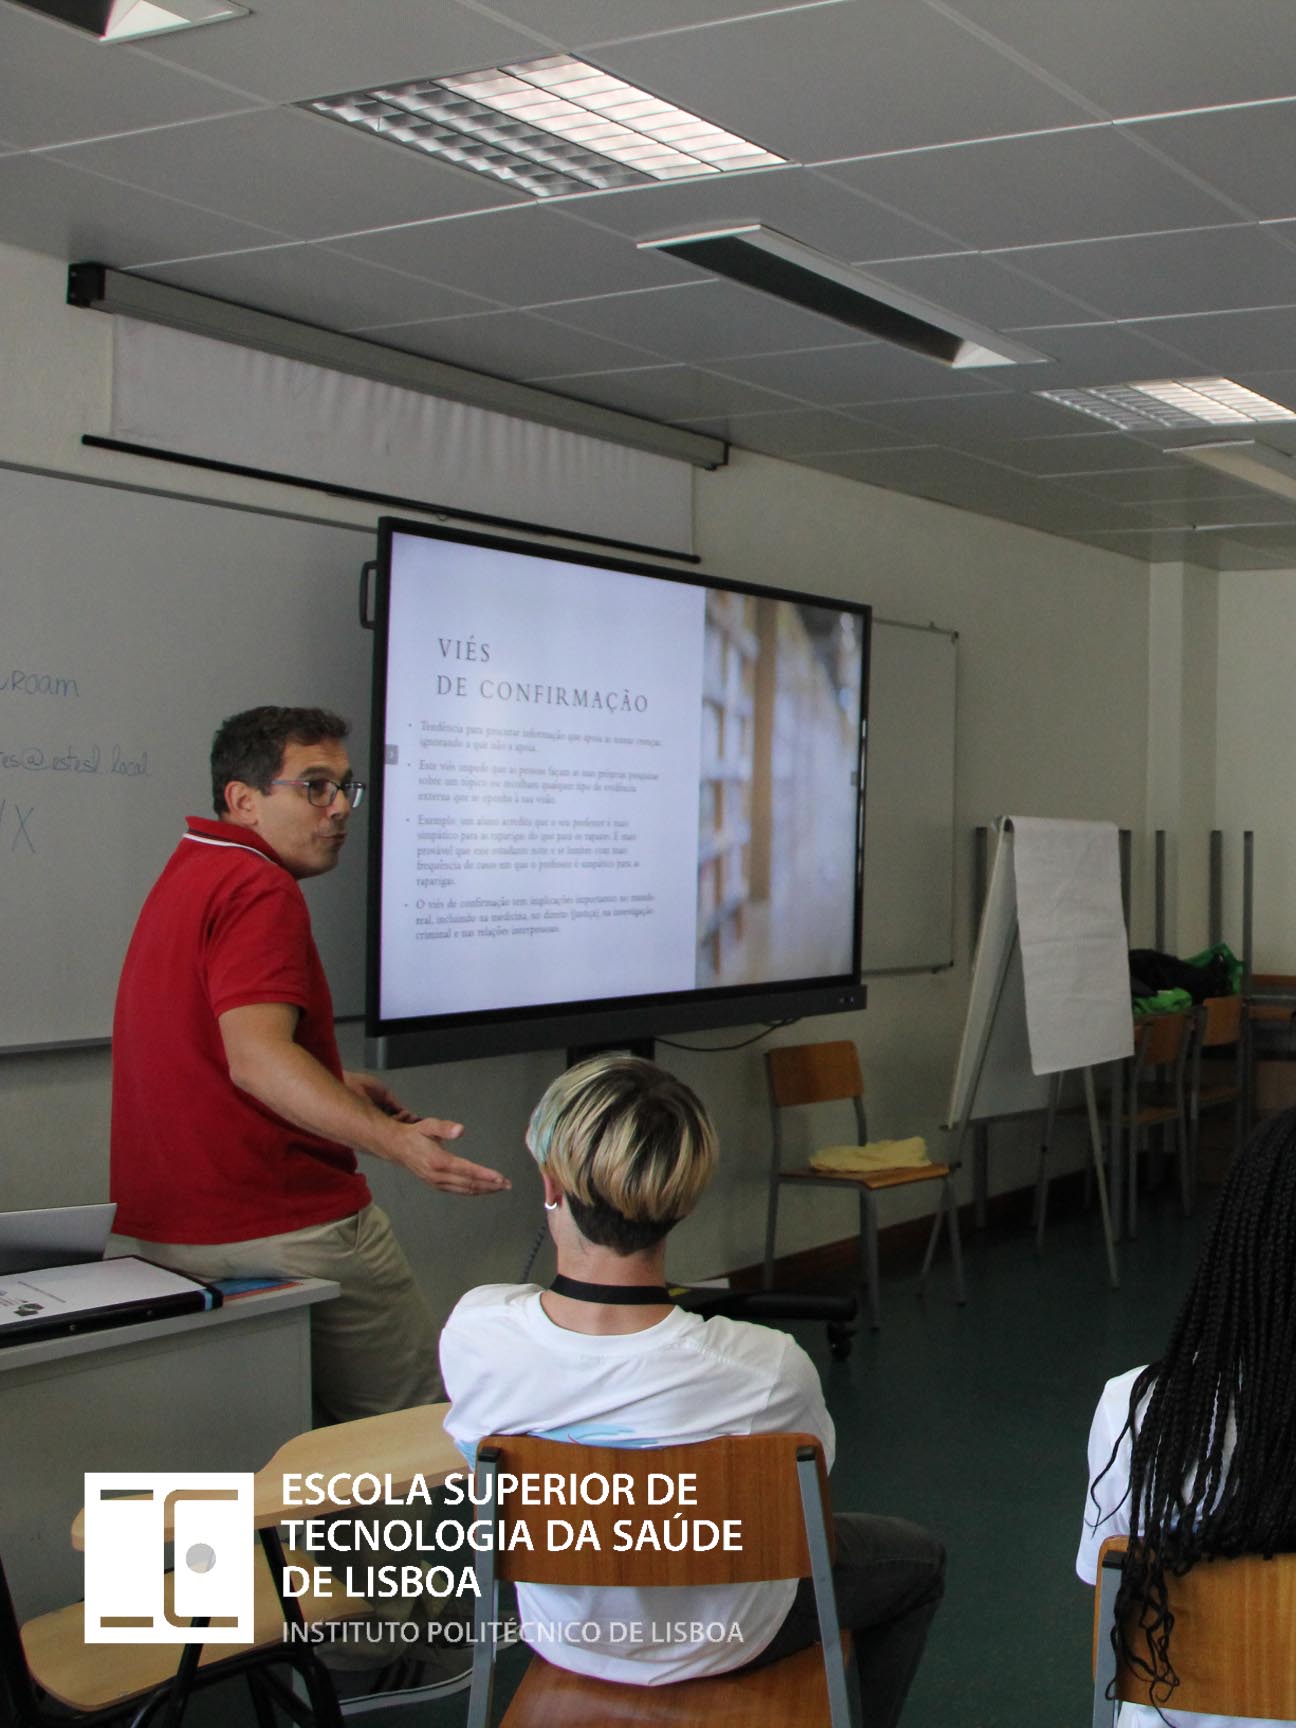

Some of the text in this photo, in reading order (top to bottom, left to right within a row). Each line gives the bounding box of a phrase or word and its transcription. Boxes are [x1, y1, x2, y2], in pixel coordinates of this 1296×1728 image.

[438, 635, 491, 662] VIÉS
[436, 674, 648, 713] DE CONFIRMAÇÃO
